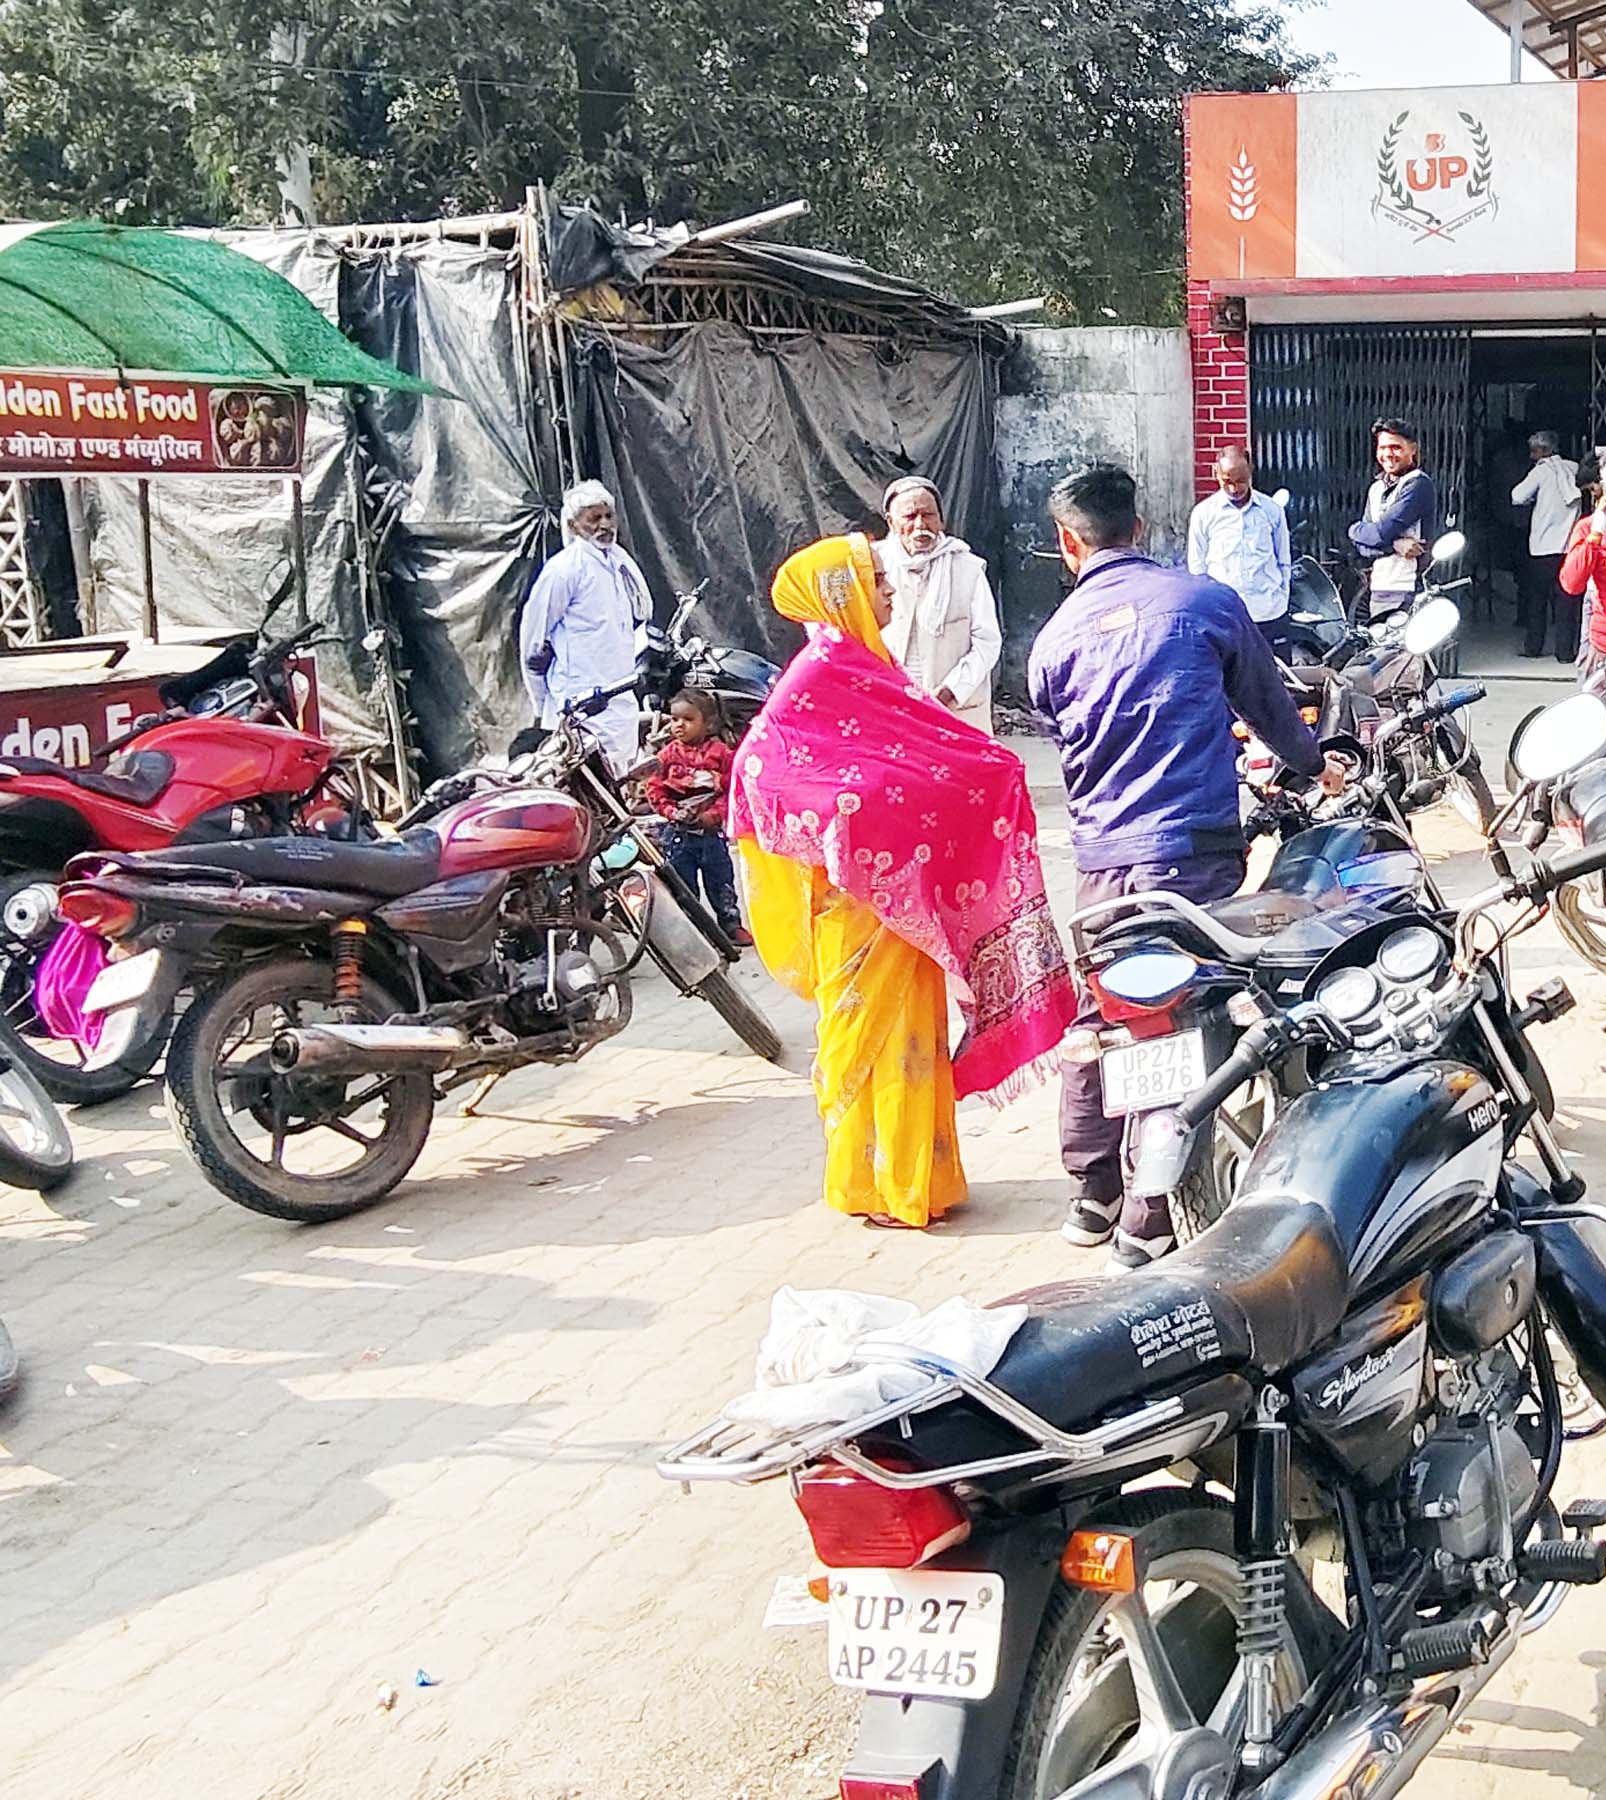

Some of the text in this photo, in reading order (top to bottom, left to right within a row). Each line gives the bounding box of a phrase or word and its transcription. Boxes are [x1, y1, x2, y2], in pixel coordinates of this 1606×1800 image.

[1406, 156, 1468, 191] UP
[68, 381, 128, 422] Fast
[134, 385, 198, 424] Food
[1123, 1036, 1193, 1075] UP27A
[1123, 1064, 1193, 1101] F8876
[854, 1595, 968, 1634] UP 27
[835, 1644, 978, 1688] AP 2445
